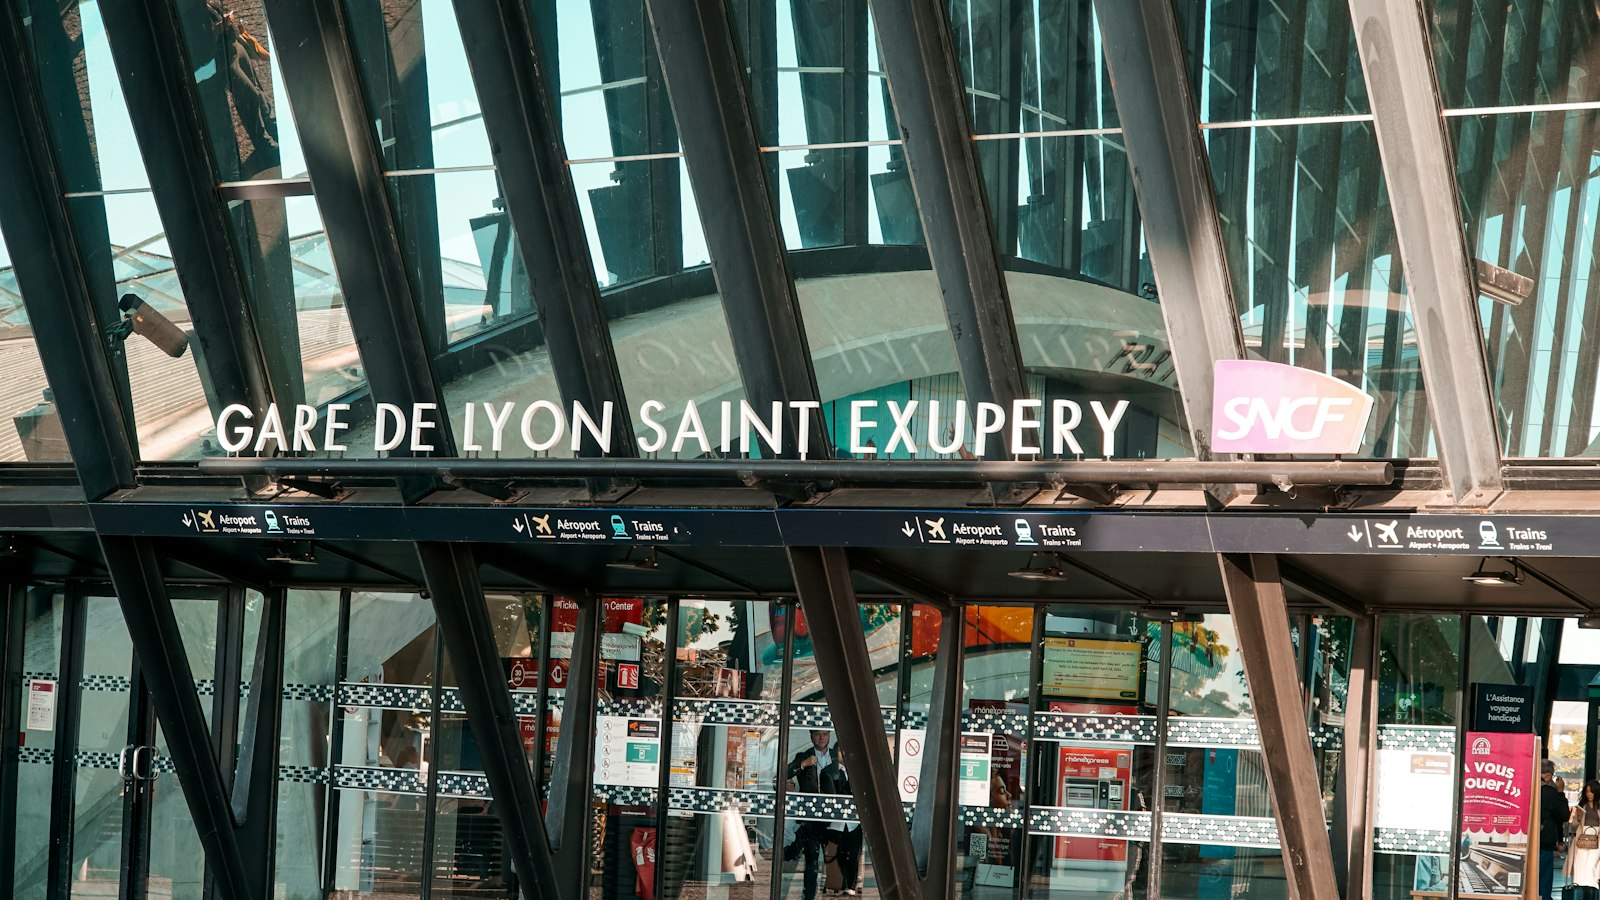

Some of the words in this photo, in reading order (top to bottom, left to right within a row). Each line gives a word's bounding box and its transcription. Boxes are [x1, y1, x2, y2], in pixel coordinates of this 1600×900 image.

[1216, 396, 1354, 441] SNCF
[216, 402, 350, 451] GARE
[374, 402, 437, 452] DE
[463, 399, 615, 453] LYON
[637, 399, 820, 455] SAINT
[849, 399, 1130, 456] EXUPERY
[220, 514, 257, 526] Aéroport
[282, 515, 310, 526] Trains
[557, 519, 600, 532] Aéroport
[631, 520, 664, 532] Trains
[953, 523, 1002, 537] Aéroport
[1039, 524, 1076, 537] Trains
[1407, 526, 1464, 540] Aéroport
[1506, 527, 1547, 540] Trains
[955, 537, 975, 545] Airport
[980, 538, 1008, 546] Aeroporto
[1408, 542, 1432, 550] Airport
[1437, 542, 1470, 550] Aeroporto
[610, 601, 634, 610] Center
[1486, 694, 1525, 703] L'Assistance
[974, 705, 1016, 715] rhônexpress
[1490, 705, 1520, 714] voyageur
[1488, 713, 1521, 724] handicapé
[1065, 756, 1109, 765] rhônexpress
[1474, 762, 1515, 779] vous
